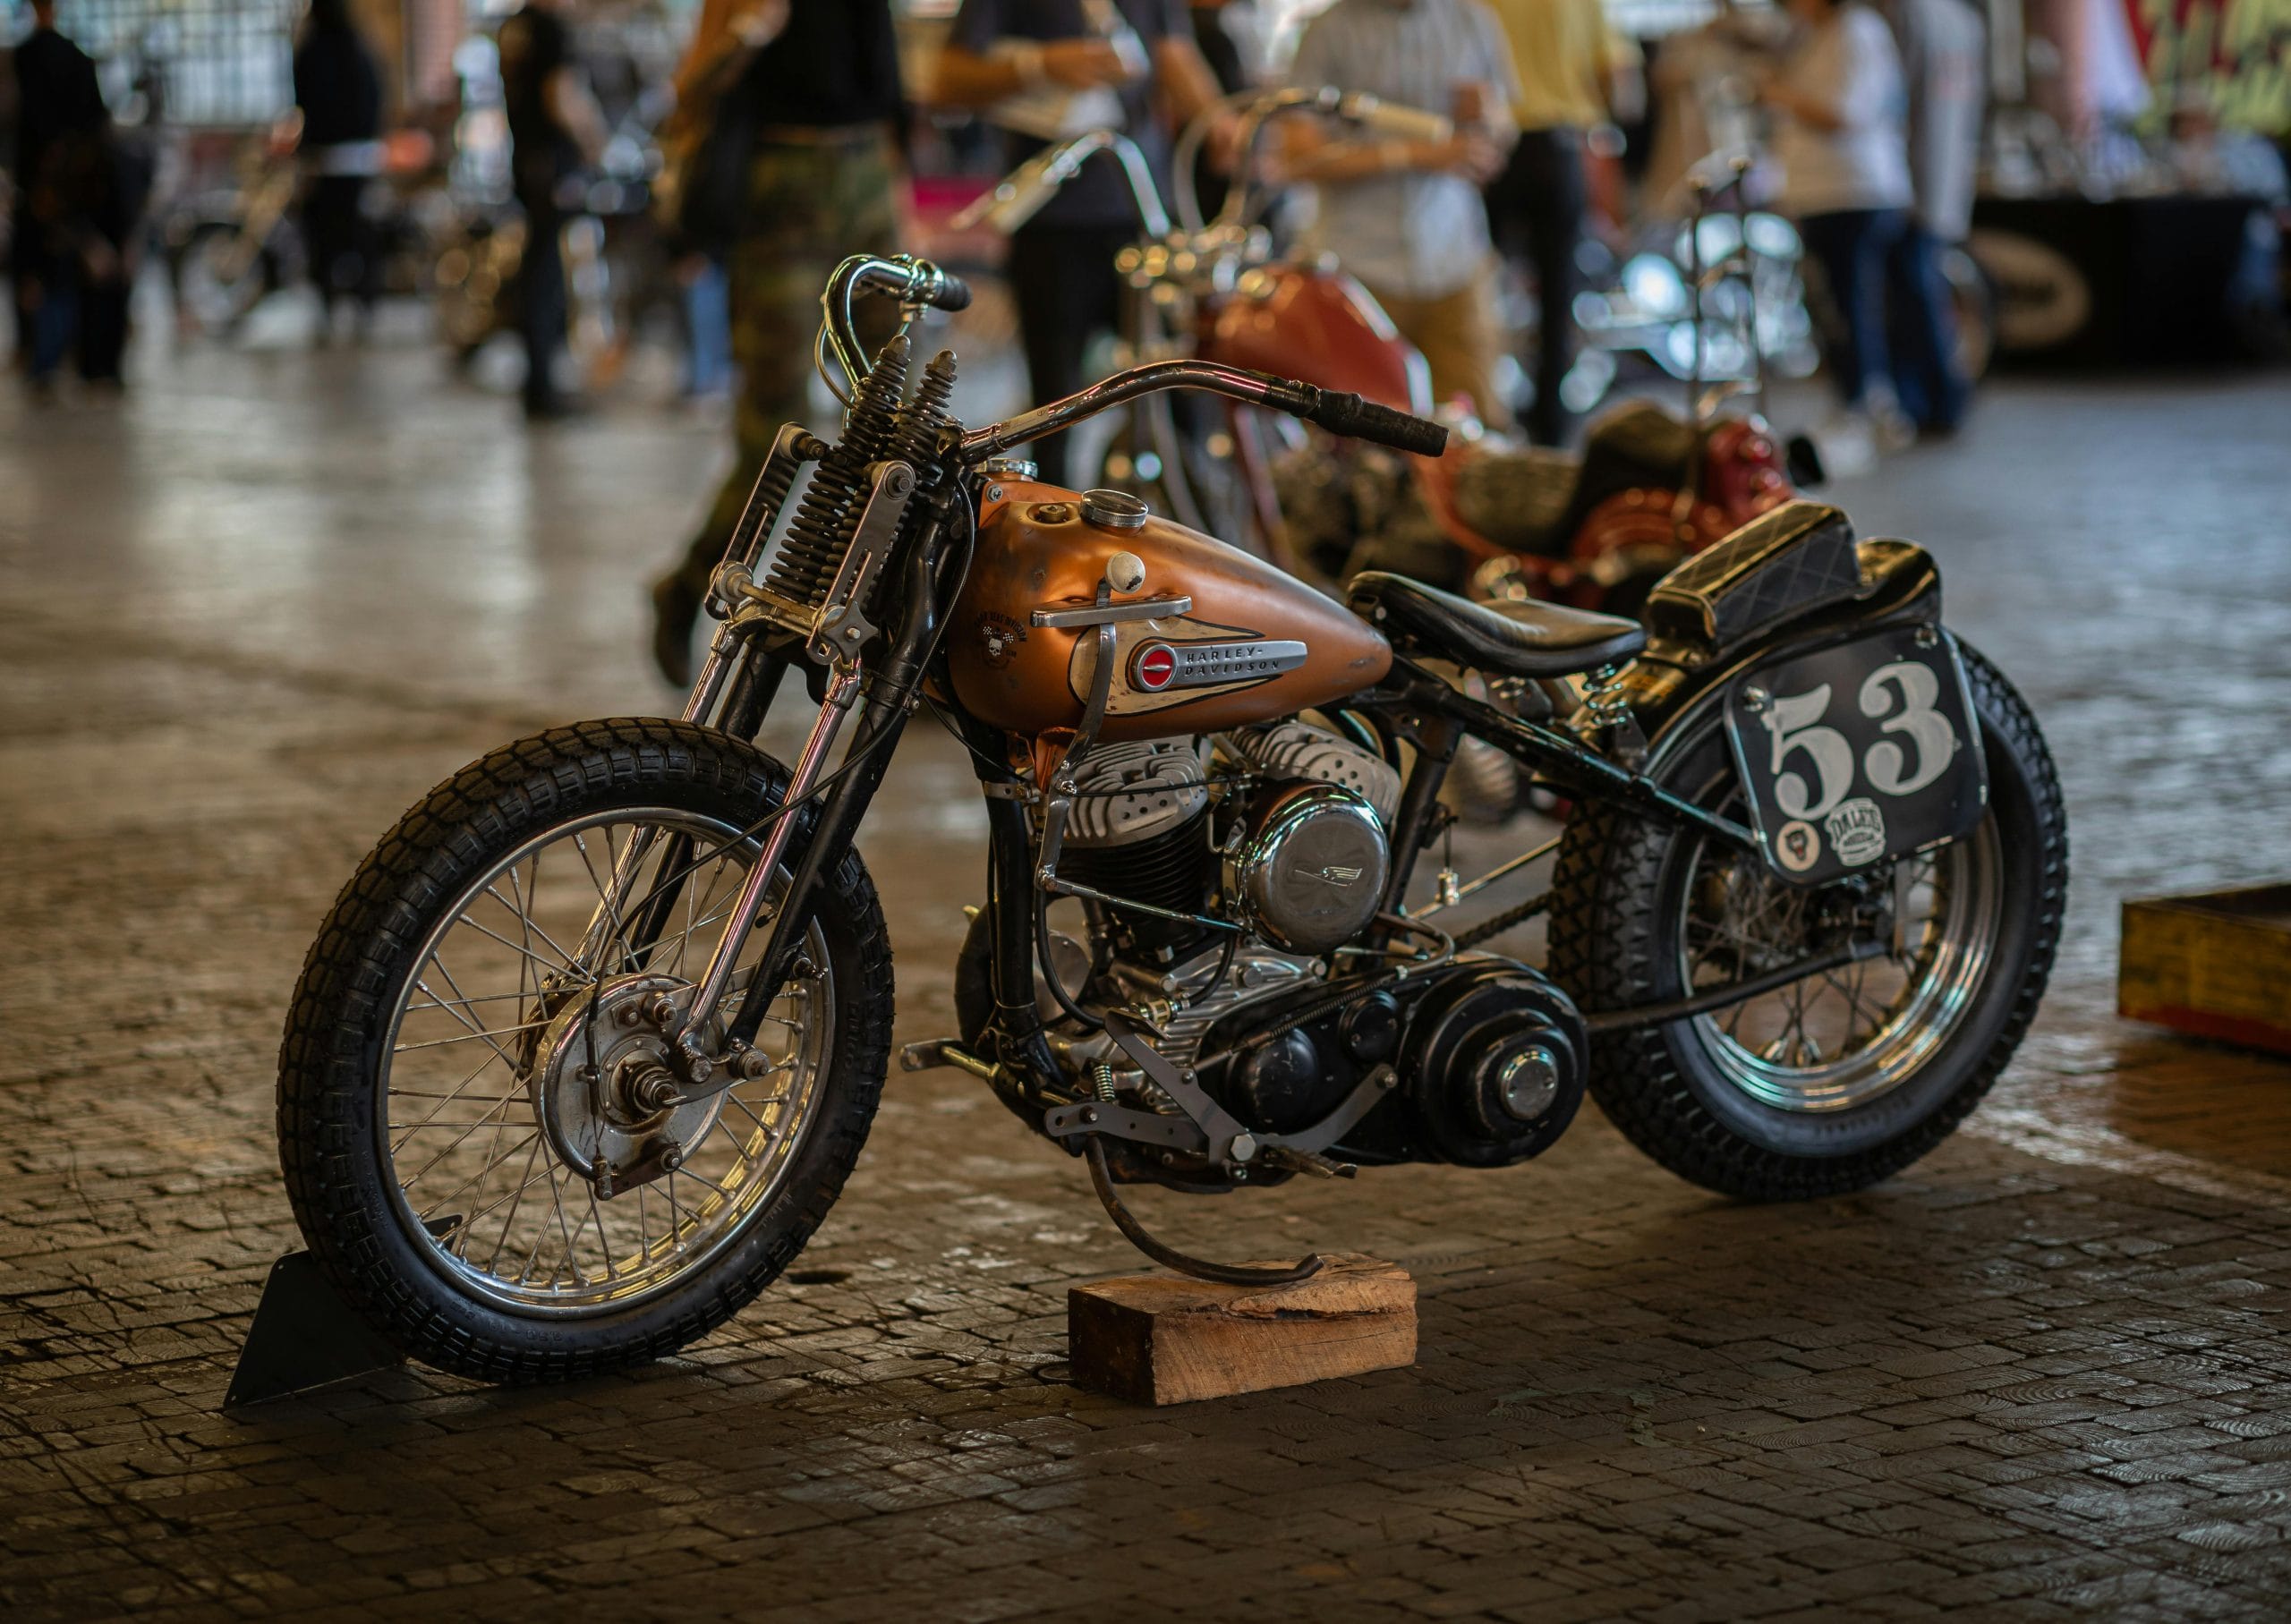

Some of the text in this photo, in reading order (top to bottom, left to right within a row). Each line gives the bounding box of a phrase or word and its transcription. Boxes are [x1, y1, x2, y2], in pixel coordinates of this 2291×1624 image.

[1187, 646, 1263, 663] HARLEY-
[1185, 660, 1281, 676] DAVIDSON
[1760, 660, 1955, 821] 53
